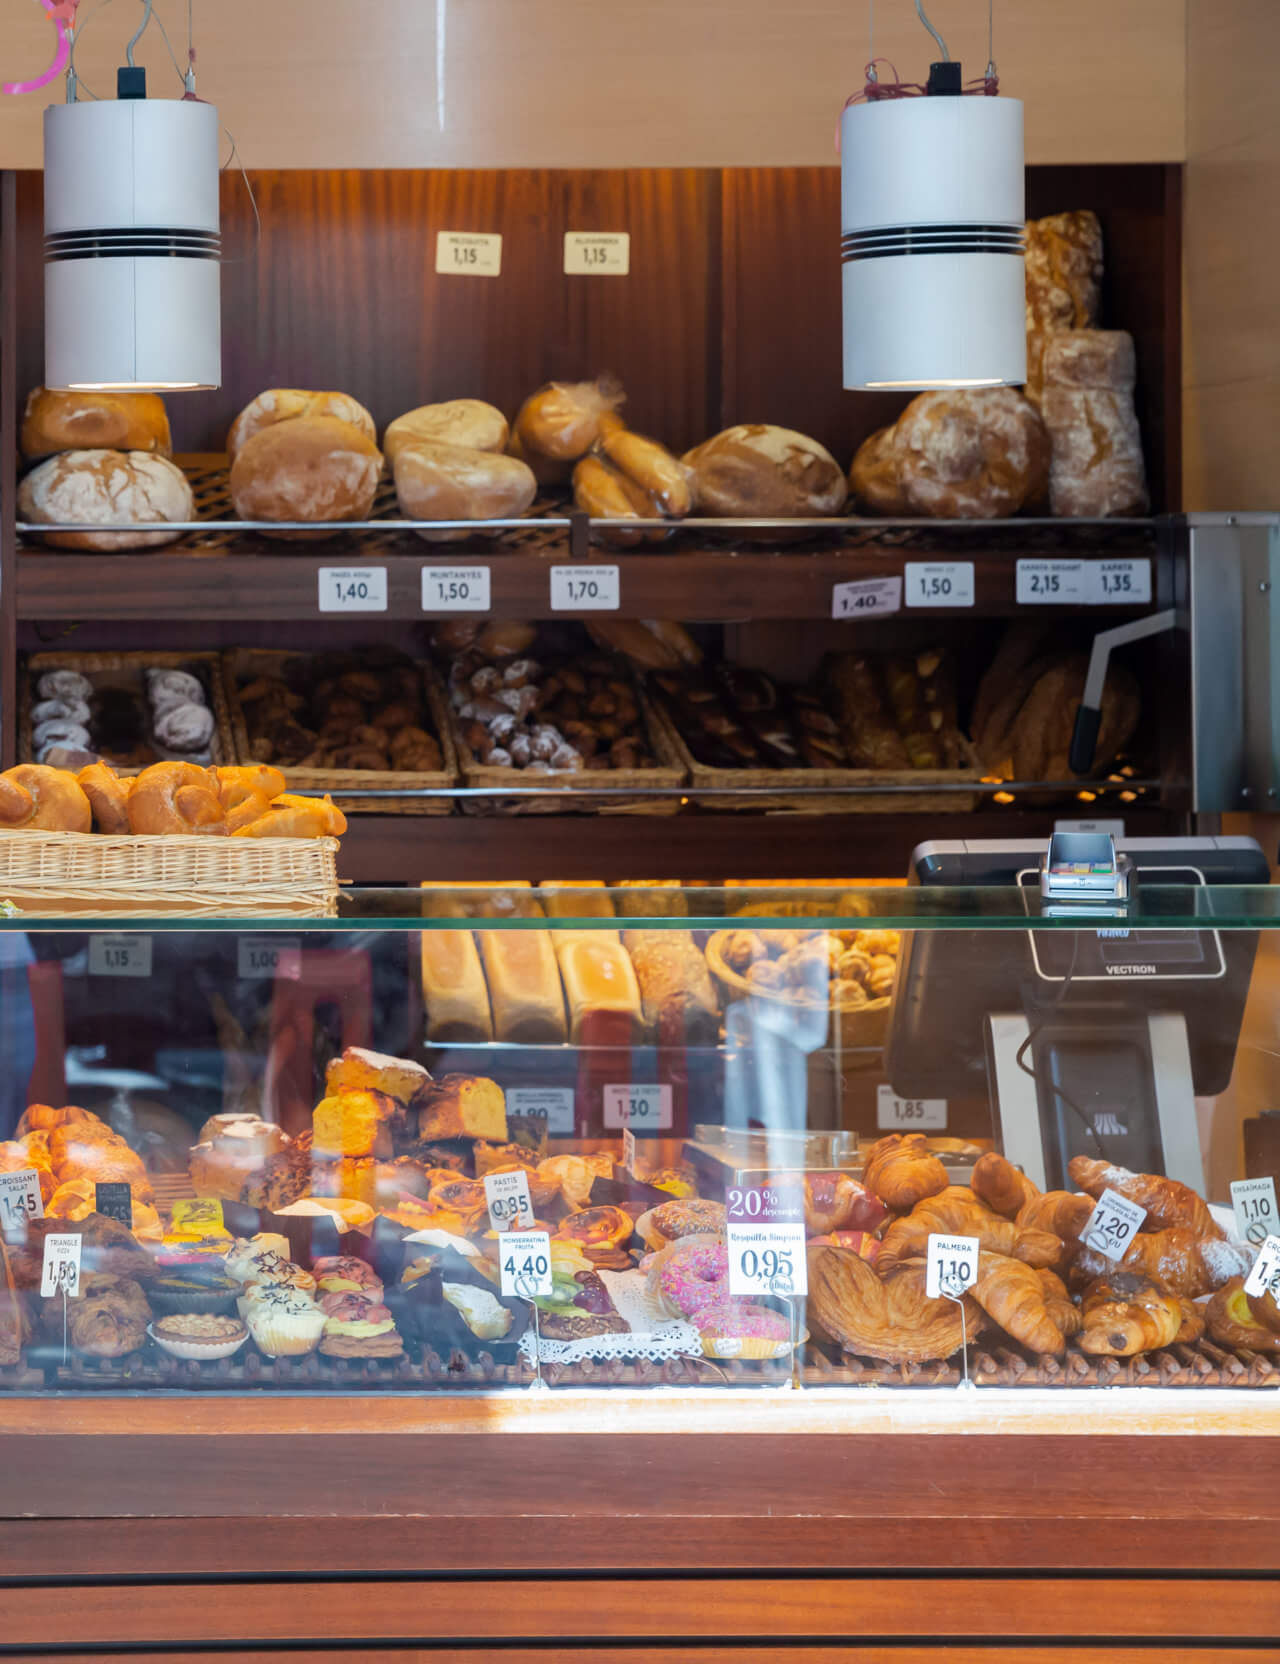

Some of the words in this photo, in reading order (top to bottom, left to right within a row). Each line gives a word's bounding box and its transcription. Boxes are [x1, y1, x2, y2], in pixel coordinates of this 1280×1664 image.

[454, 248, 477, 266] 1,15
[584, 248, 607, 266] 1,15
[336, 582, 368, 602] 1,40
[438, 583, 469, 602] 1,50
[568, 581, 598, 601] 1,70
[920, 578, 951, 598] 1,50
[1030, 575, 1060, 594] 2,15
[1102, 575, 1131, 594] 1,35
[840, 595, 877, 612] 1,40
[105, 950, 129, 968] 1,15
[250, 951, 280, 969] 1,00
[1105, 965, 1157, 975] VECTRON
[618, 1099, 649, 1119] 1,30
[894, 1101, 924, 1121] 1,85
[1241, 1198, 1270, 1221] 1,10
[1094, 1210, 1129, 1239] 1,20
[50, 1239, 78, 1247] TRIANGLE
[937, 1242, 972, 1252] PALMERA
[741, 1249, 793, 1281] 0,95
